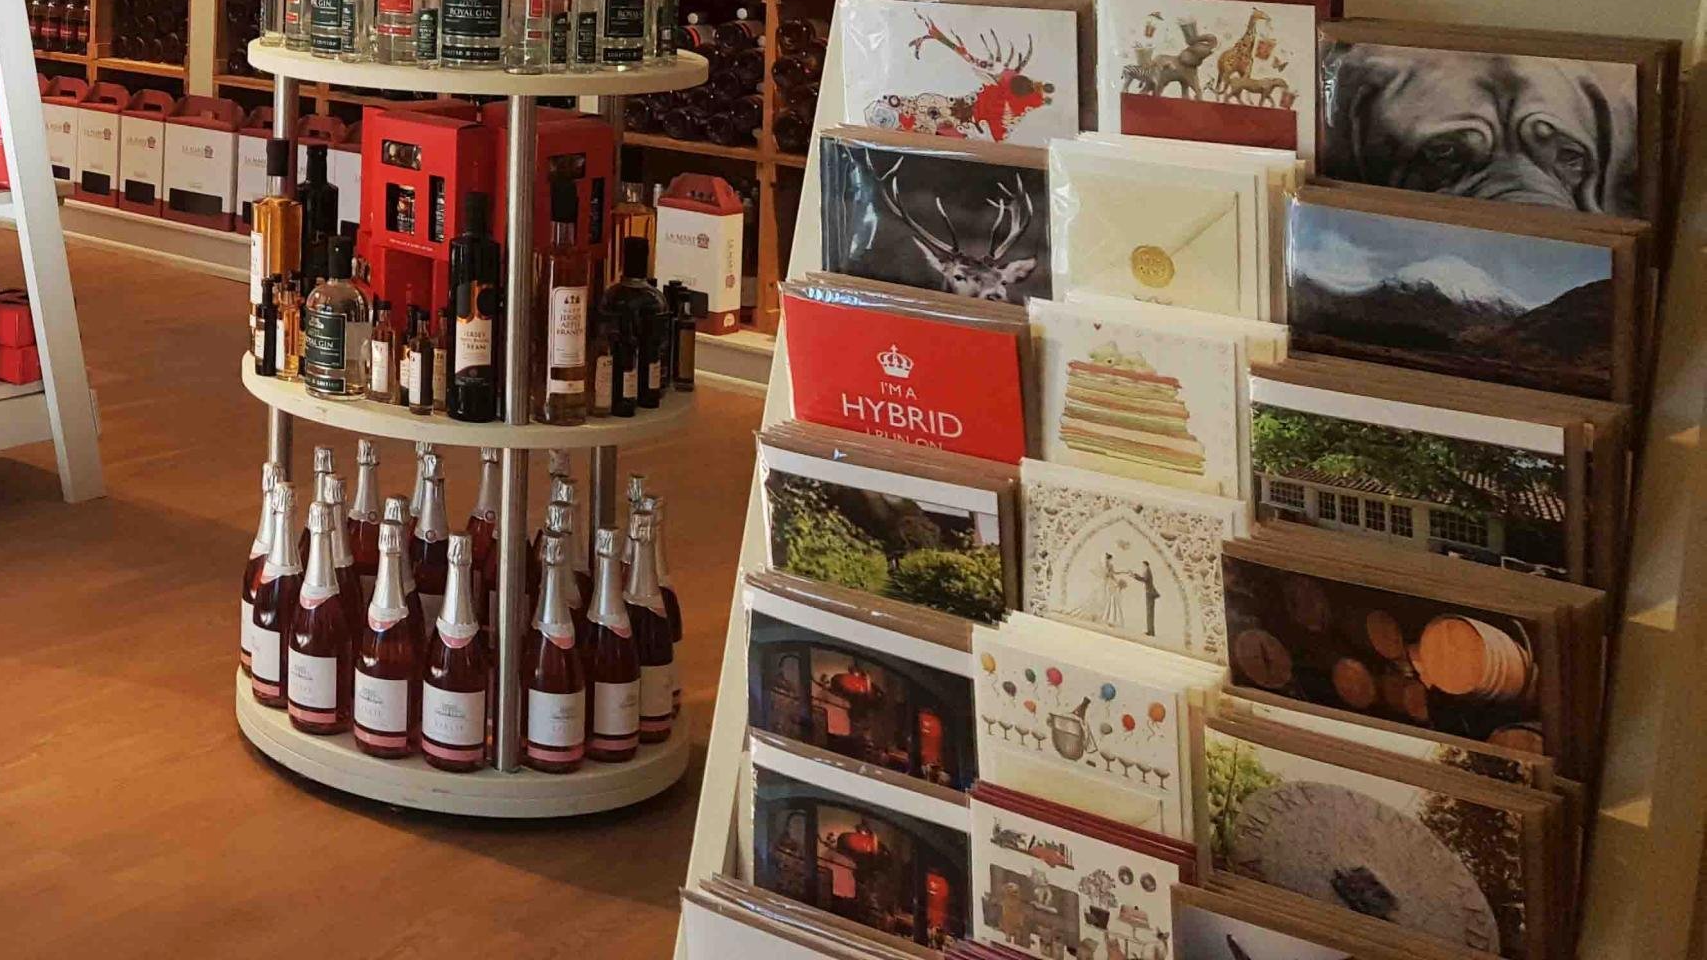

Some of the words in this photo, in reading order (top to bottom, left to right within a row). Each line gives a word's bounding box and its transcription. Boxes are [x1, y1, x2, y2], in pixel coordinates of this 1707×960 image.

[318, 0, 332, 8] GIN
[449, 7, 474, 17] ROYAL
[476, 7, 493, 17] GIN
[318, 341, 334, 349] GIN
[880, 381, 902, 398] I'M
[905, 386, 918, 400] A
[841, 392, 964, 439] HYBRID
